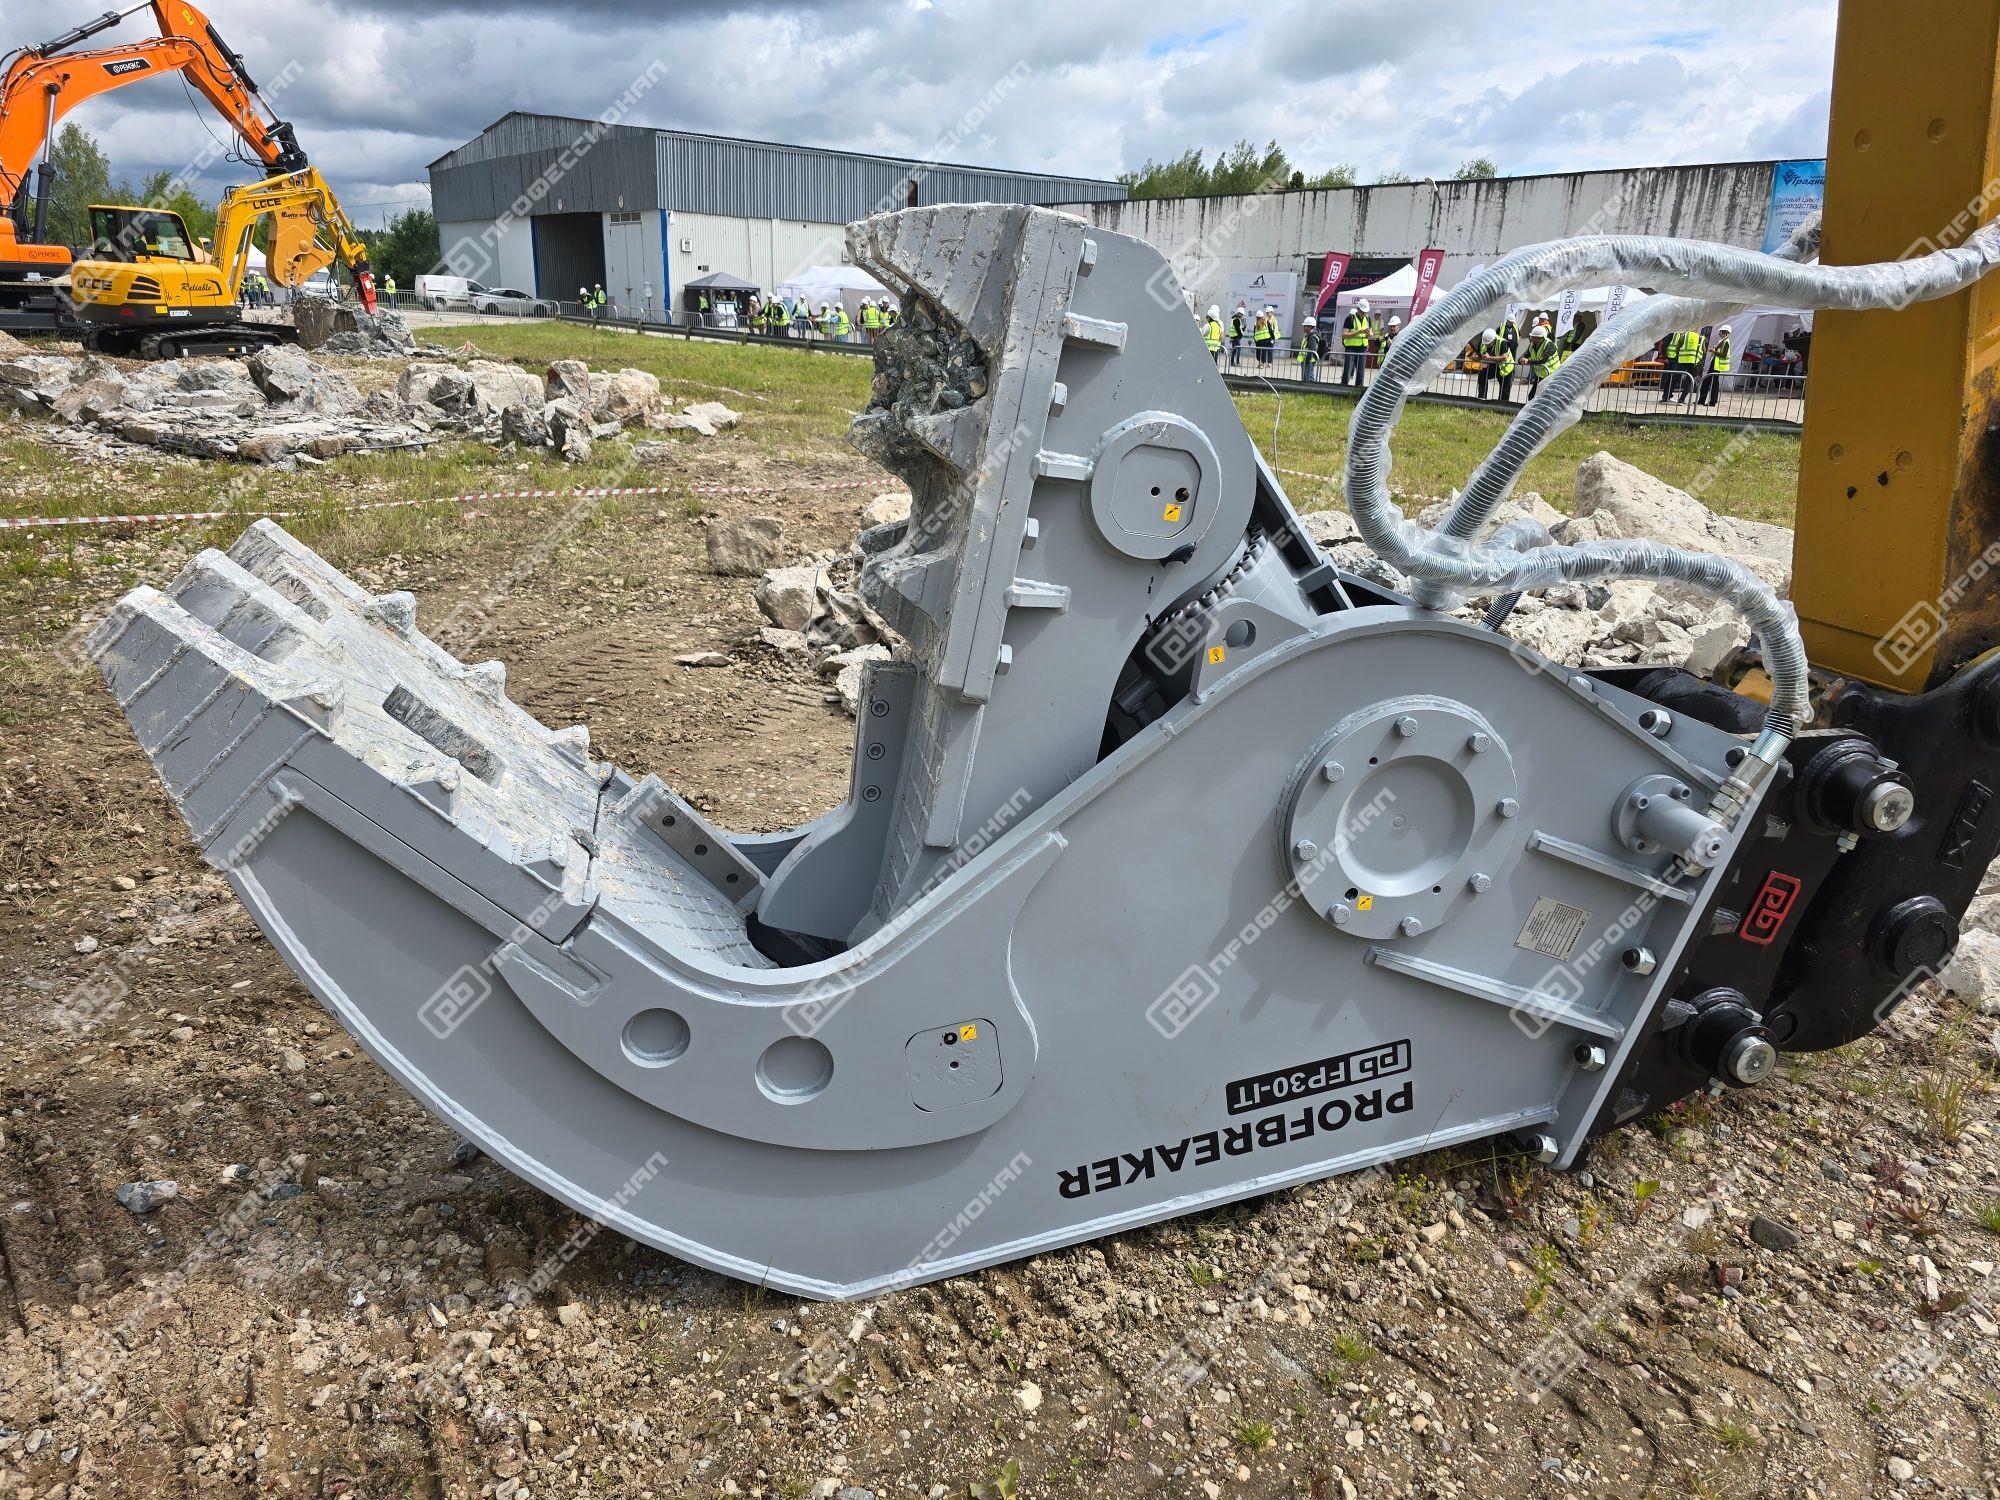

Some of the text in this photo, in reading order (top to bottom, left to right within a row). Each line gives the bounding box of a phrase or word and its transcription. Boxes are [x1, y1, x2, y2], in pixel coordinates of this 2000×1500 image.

[119, 61, 141, 73] РЕМЭКС
[252, 197, 282, 210] LGCE
[180, 282, 212, 292] Reliable
[1233, 1061, 1348, 1110] FP30-IT
[1057, 1080, 1414, 1200] PROFBREAKER
